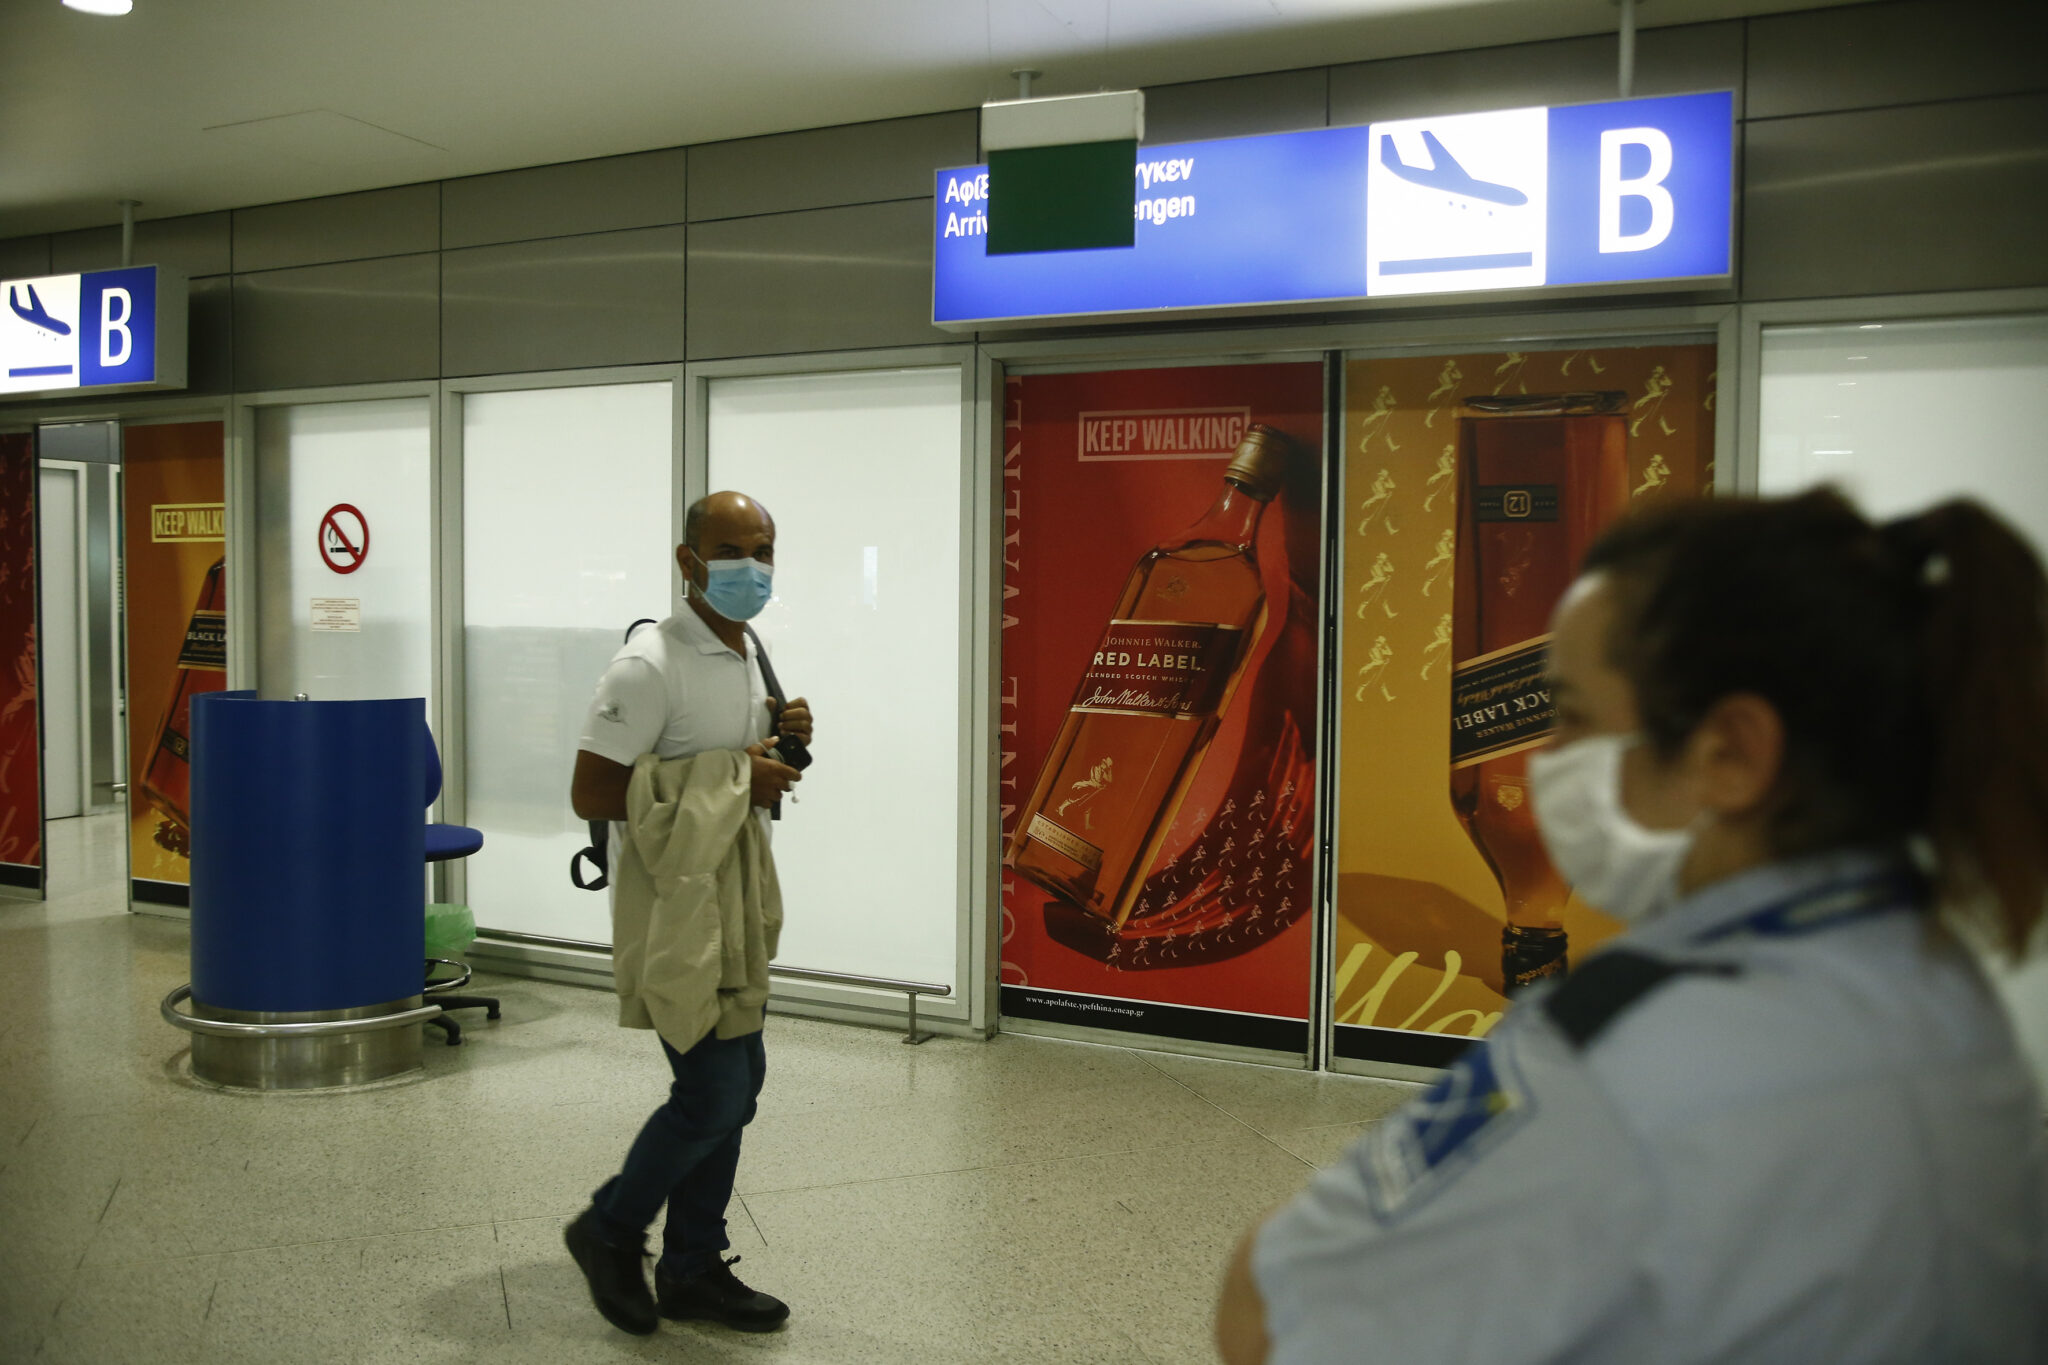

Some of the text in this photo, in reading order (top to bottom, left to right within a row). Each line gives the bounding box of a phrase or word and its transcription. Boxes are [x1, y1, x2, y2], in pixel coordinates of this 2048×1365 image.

[944, 158, 1194, 207] Αφίξ γκεν
[1599, 127, 1674, 253] B
[944, 195, 1195, 238] Arriv ngen
[100, 287, 132, 367] B
[1086, 416, 1242, 452] KEEP WALKING
[156, 510, 225, 536] KEEP WALKI
[1093, 652, 1131, 666] RED
[1105, 637, 1152, 648] JOHNNIE
[1512, 688, 1552, 712] ACK
